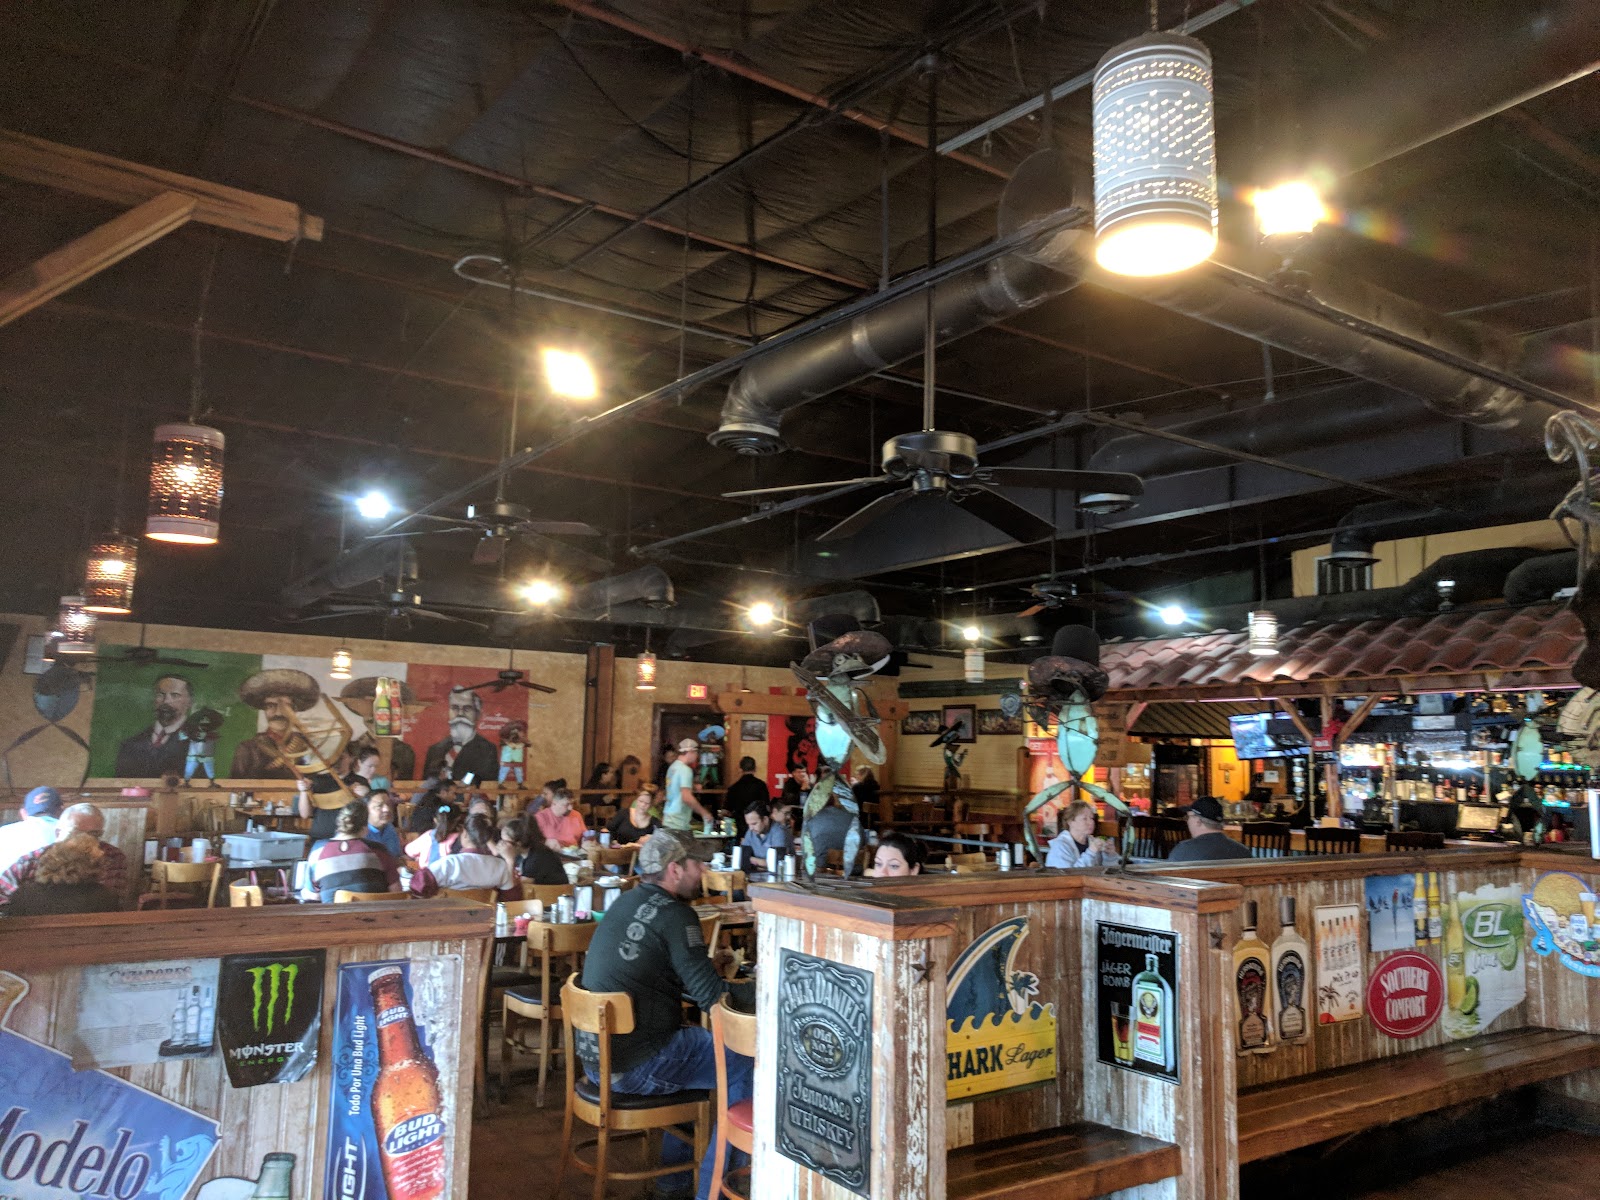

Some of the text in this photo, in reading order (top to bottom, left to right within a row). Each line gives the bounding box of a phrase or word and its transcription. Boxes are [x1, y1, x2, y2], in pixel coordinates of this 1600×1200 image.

[1473, 910, 1511, 938] BL
[1100, 926, 1172, 955] Jägermeister
[1100, 959, 1132, 976] JÄGER
[1103, 975, 1131, 989] BOMB
[1380, 966, 1430, 998] SOUTHERN
[784, 978, 815, 1014] JACK
[1385, 995, 1427, 1023] COMFORT
[381, 1006, 406, 1019] BUD
[229, 1041, 305, 1061] MONSTER
[352, 1040, 364, 1057] Bud
[947, 1042, 1054, 1081] HARK Lager
[351, 1059, 363, 1076] Una
[350, 1078, 362, 1093] Por
[348, 1094, 361, 1116] Todo
[388, 1123, 442, 1154] LIGHT
[393, 1113, 437, 1139] BUD
[788, 1104, 855, 1151] WHISKEY
[341, 1136, 358, 1200] IGHT
